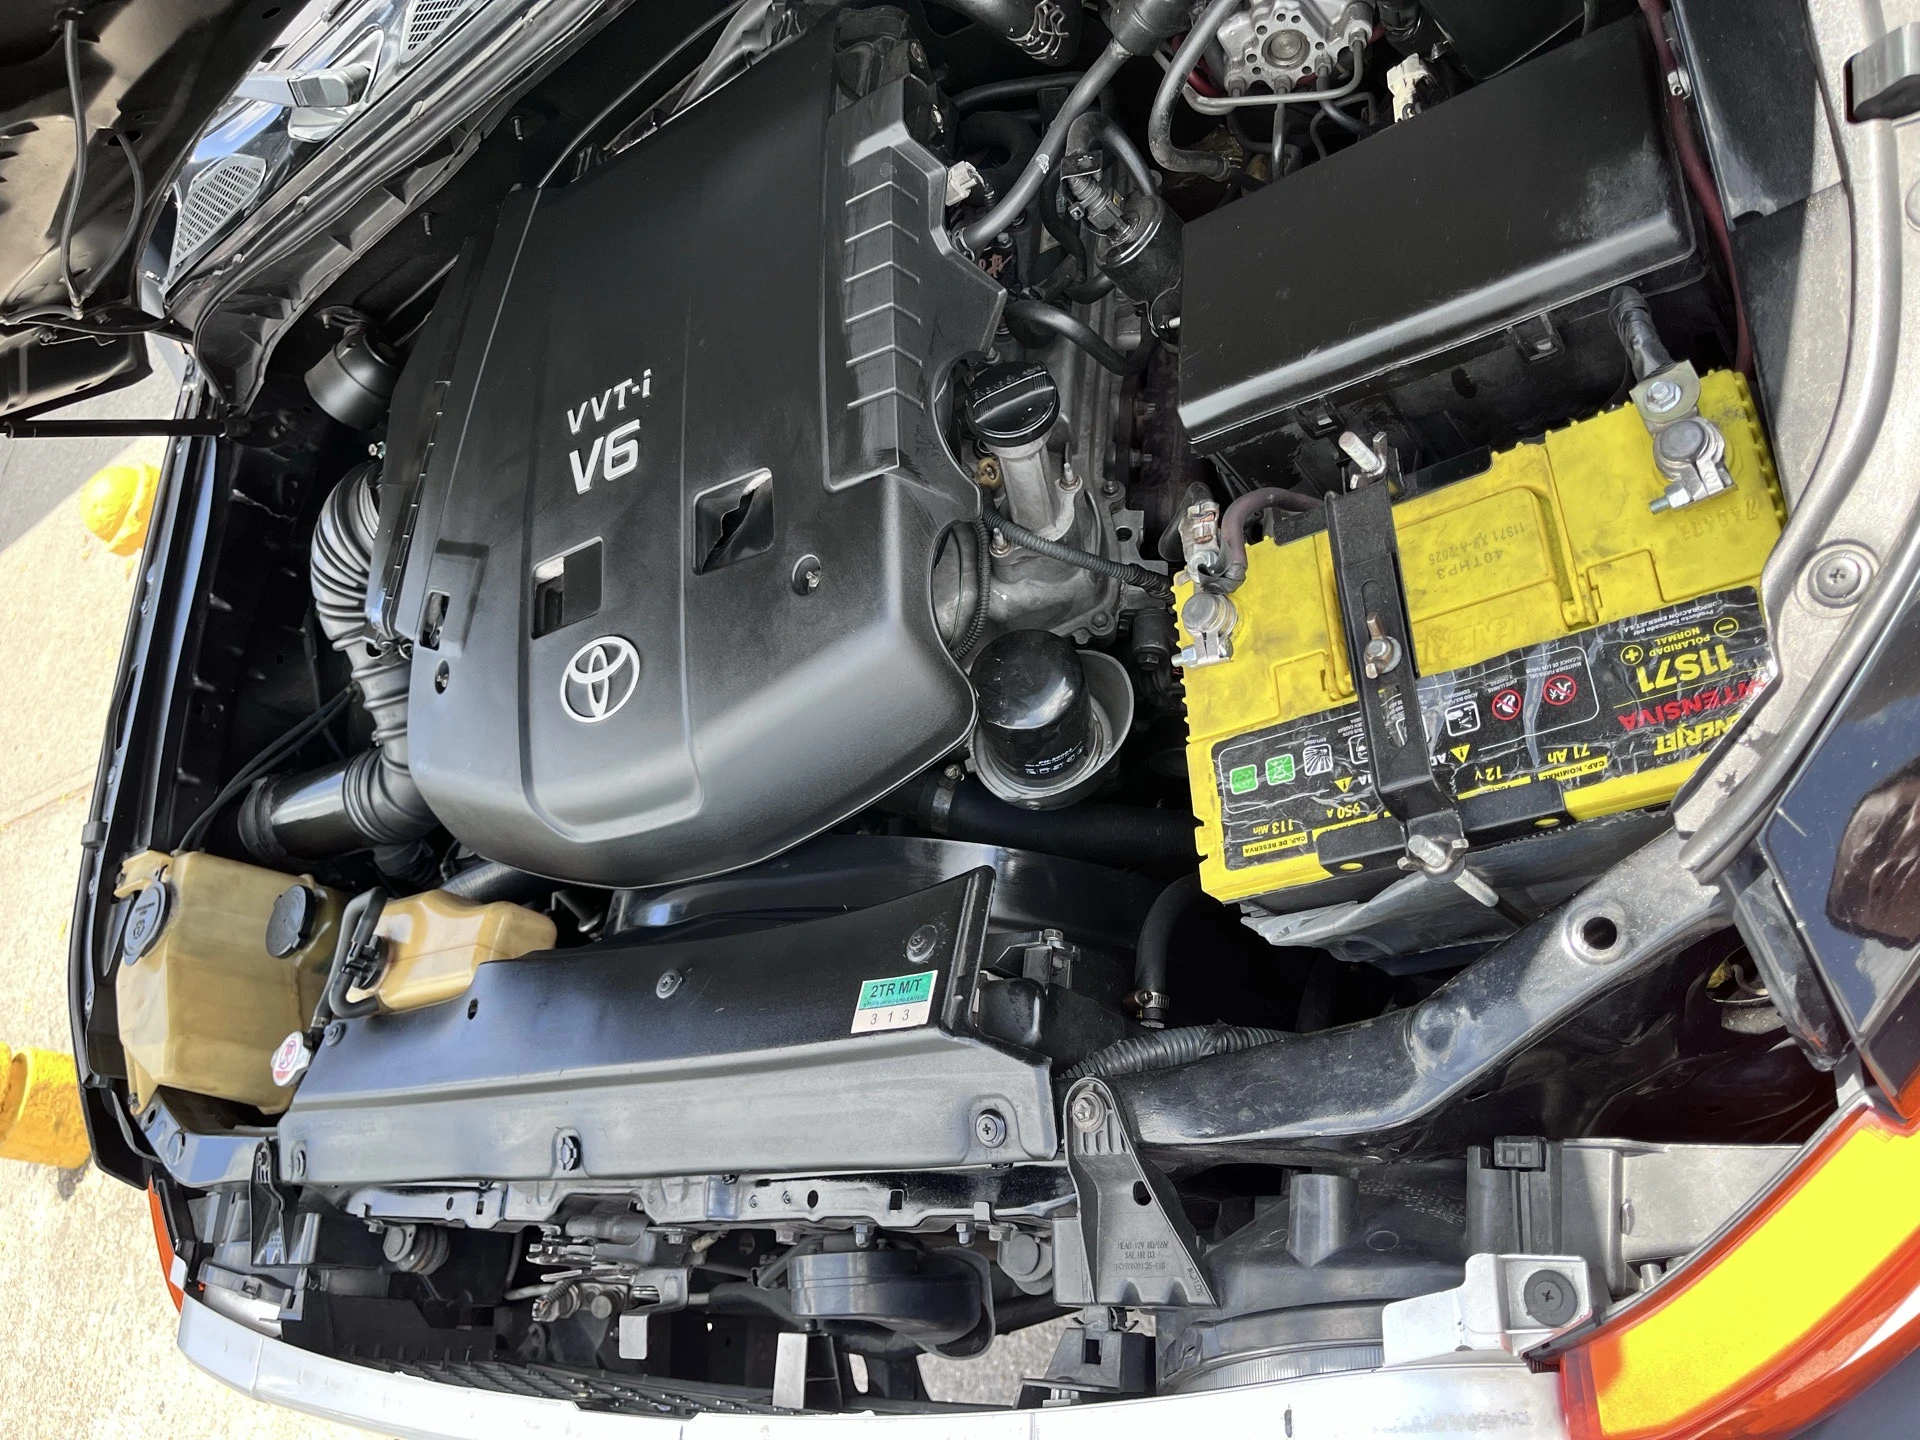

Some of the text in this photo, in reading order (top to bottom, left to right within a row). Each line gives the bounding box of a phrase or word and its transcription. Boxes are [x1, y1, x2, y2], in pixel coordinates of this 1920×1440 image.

[567, 369, 651, 434] VVT-i
[569, 419, 640, 494] V6
[1493, 522, 1524, 541] 11S71
[1633, 609, 1714, 636] Producto fabricado por
[1648, 634, 1710, 656] POLARIDAD
[1654, 626, 1700, 646] NORMAL
[1539, 668, 1554, 677] FUERA
[1555, 661, 1582, 672] MANTENER
[1636, 644, 1734, 693] 11S71
[1547, 743, 1590, 764] 71 Ah
[1486, 766, 1502, 781] 12
[1583, 760, 1605, 770] CAP.
[1326, 803, 1360, 819] 950 A
[1253, 818, 1294, 835] 113 Min
[1244, 842, 1277, 854] RESERVA
[1289, 836, 1306, 844] CAP.
[870, 979, 922, 998] 2TR M/T
